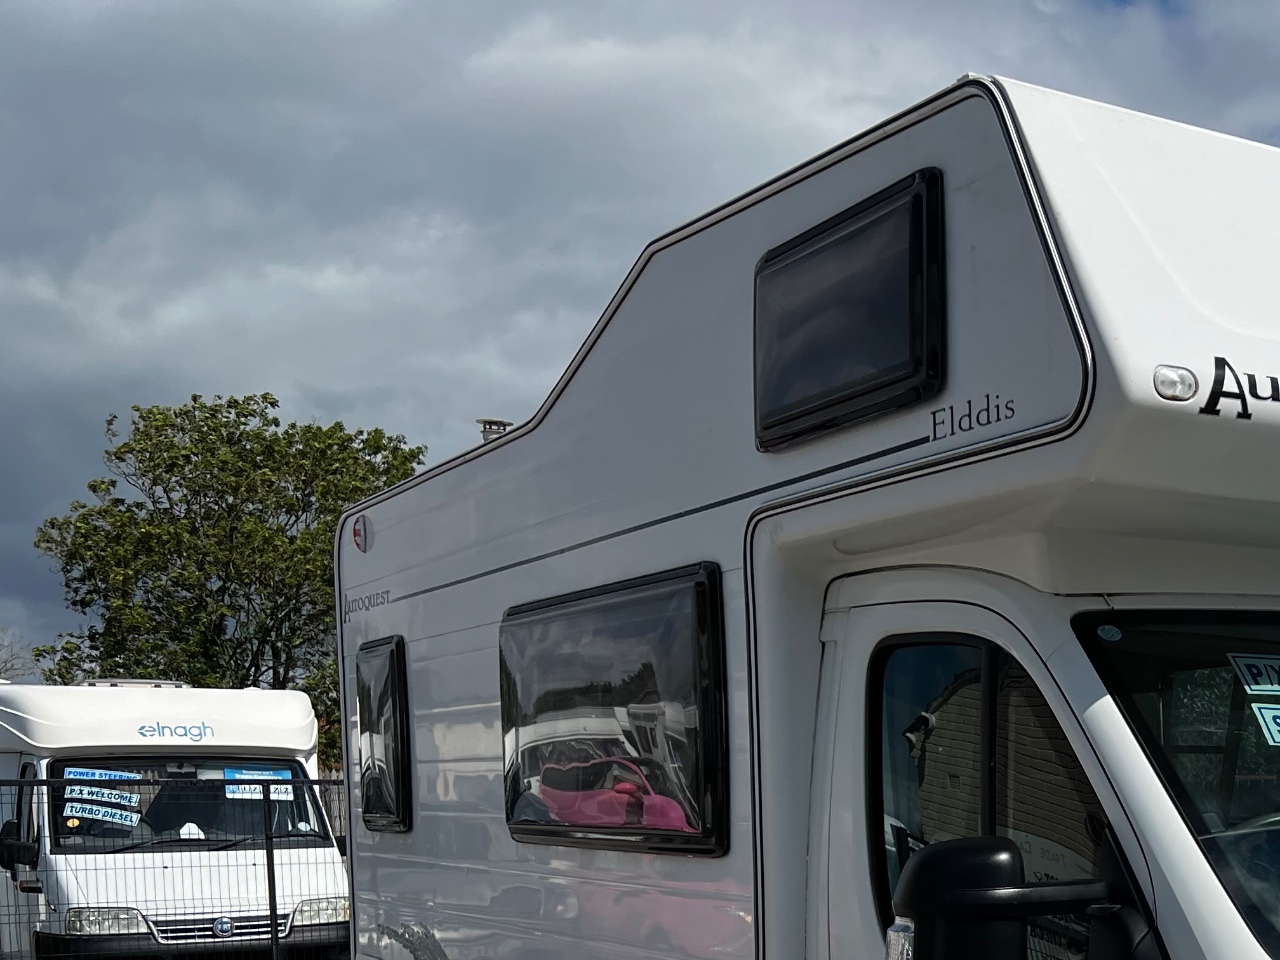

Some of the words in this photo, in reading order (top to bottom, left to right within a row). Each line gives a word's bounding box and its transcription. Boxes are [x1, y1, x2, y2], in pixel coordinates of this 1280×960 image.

[930, 394, 1015, 441] Elddis
[343, 589, 391, 624] AUTOQUEST
[138, 721, 215, 742] elnagh
[67, 770, 96, 778] POWER
[69, 788, 84, 796] P/X
[87, 790, 135, 803] WELCOME
[69, 805, 101, 817] TURBO
[102, 810, 134, 823] DIESEL
